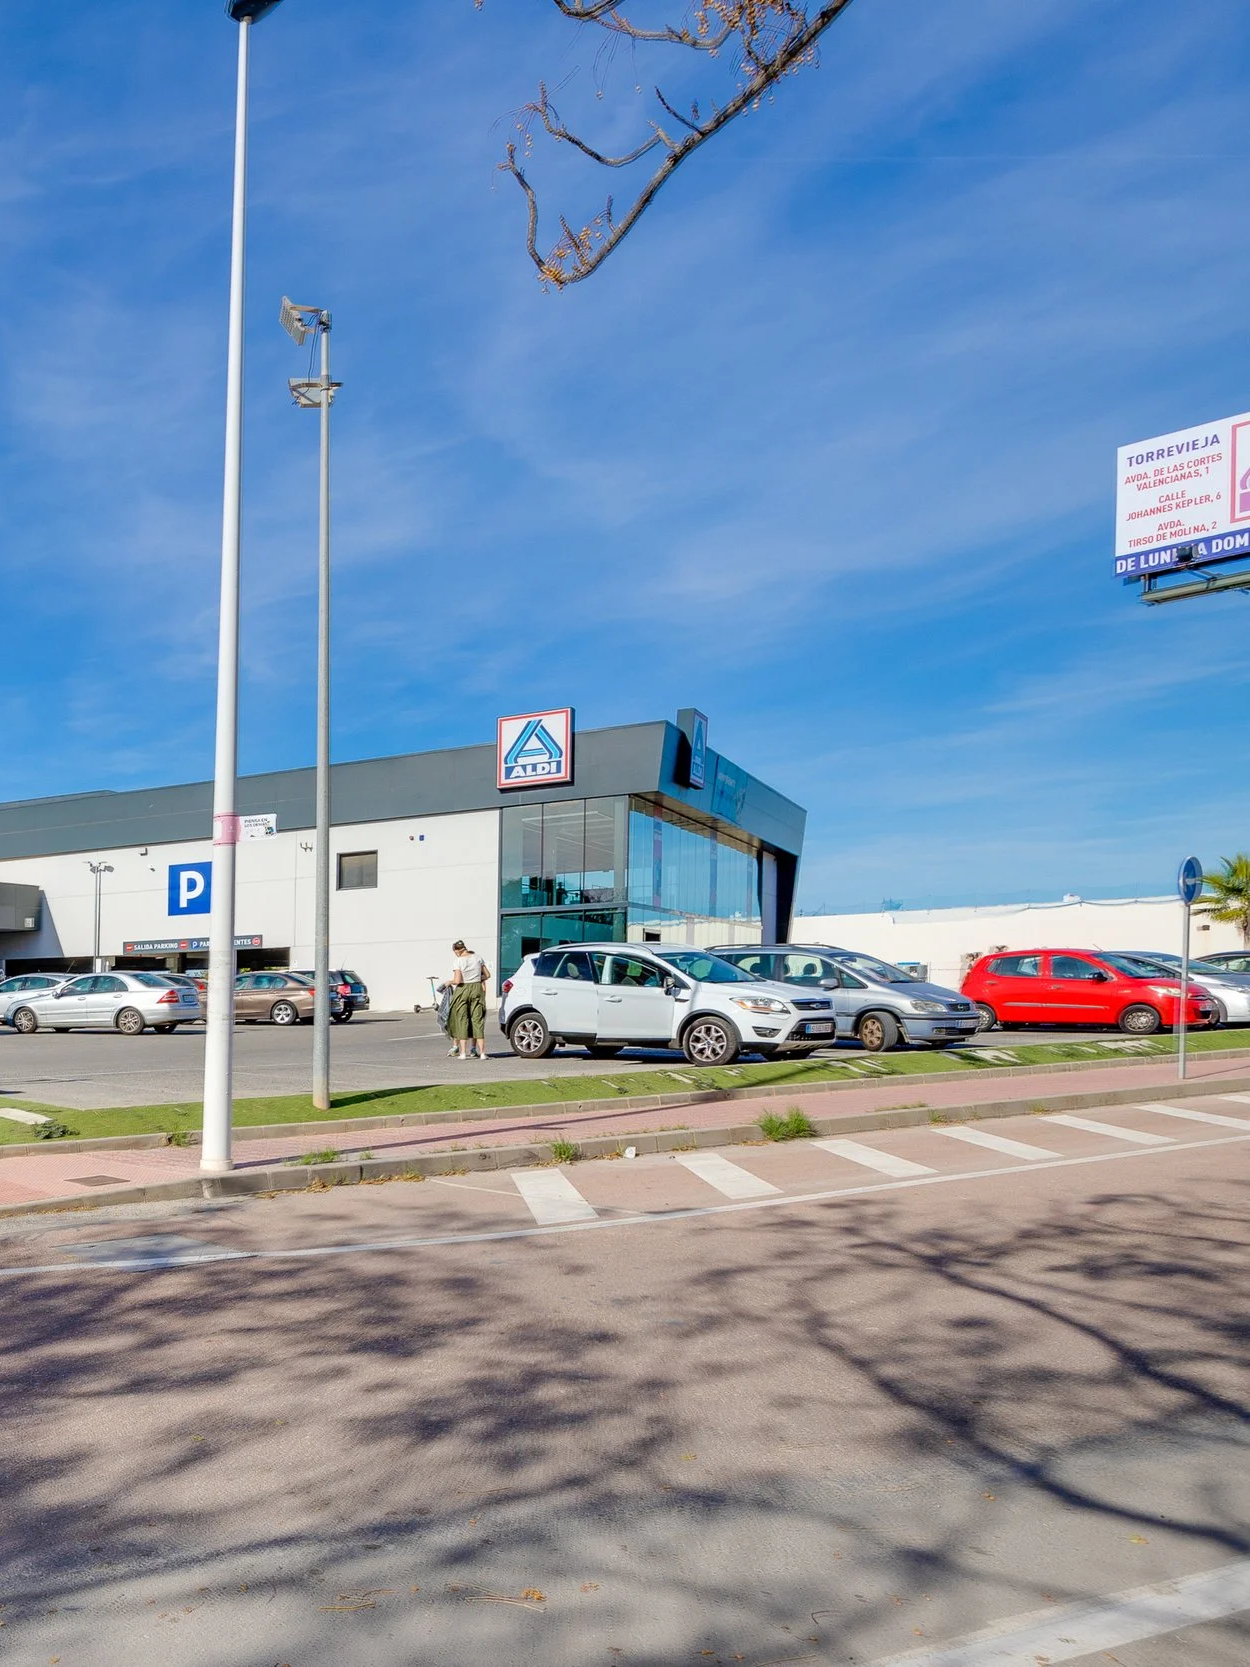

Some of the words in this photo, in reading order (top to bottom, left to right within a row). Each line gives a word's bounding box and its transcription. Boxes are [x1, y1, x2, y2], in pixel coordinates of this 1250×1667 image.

[1126, 433, 1220, 467] TORREVIEJA
[1124, 471, 1152, 485] AVDA.
[1153, 467, 1165, 478] DE
[1167, 462, 1185, 474] LAS
[1186, 452, 1223, 469] CORTES
[1205, 466, 1209, 475] 1
[1126, 503, 1173, 521] JOHANNES
[1215, 491, 1222, 500] 6
[1158, 490, 1186, 503] CALLE
[1127, 535, 1154, 548] TIRSO
[1156, 532, 1168, 542] DE
[1211, 521, 1217, 530] 2
[1157, 519, 1185, 531] AVDA.
[1116, 556, 1136, 574] DE
[1197, 542, 1208, 556] A
[509, 761, 557, 778] ALDI
[178, 870, 205, 908] P
[154, 942, 178, 950] PARKING
